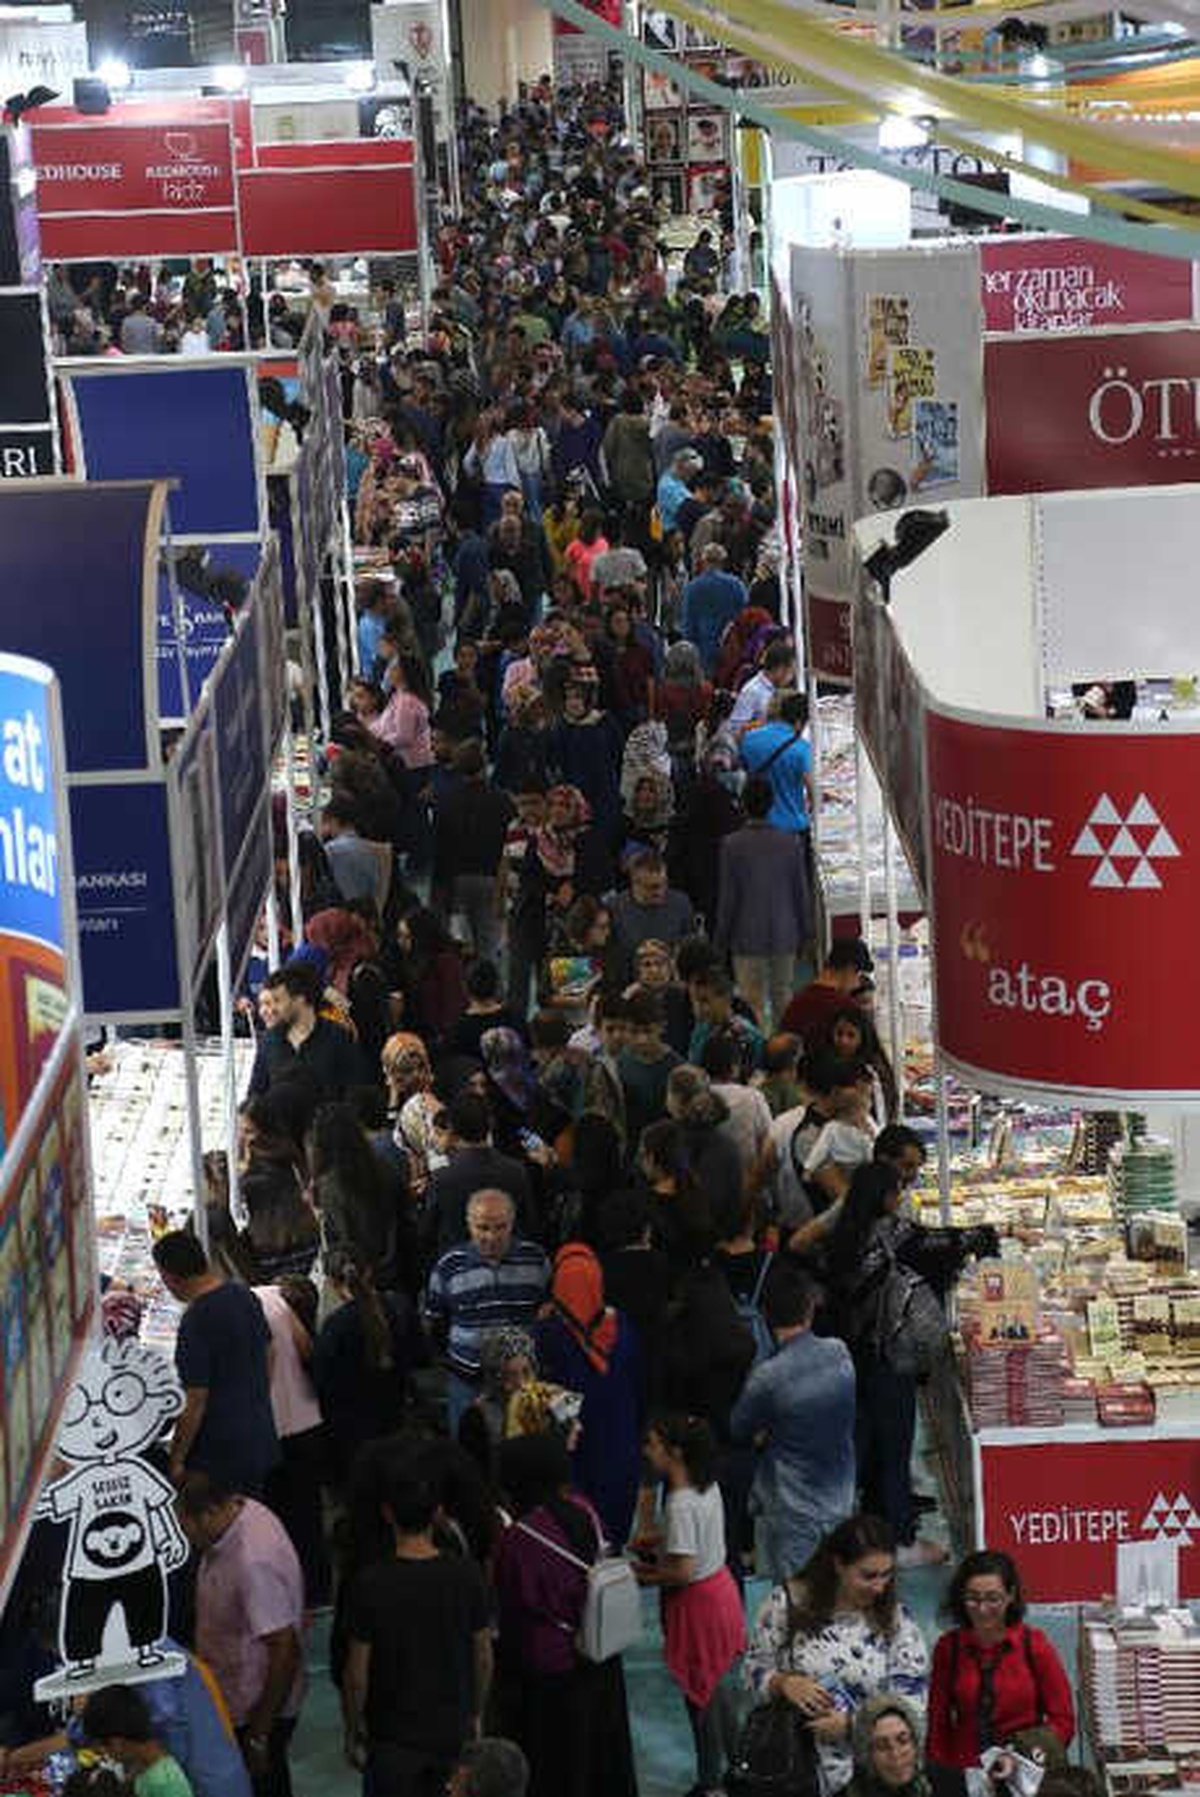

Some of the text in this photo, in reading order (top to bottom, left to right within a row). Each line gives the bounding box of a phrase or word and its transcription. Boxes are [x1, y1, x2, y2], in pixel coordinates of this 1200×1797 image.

[35, 164, 123, 181] EDHOUSE
[1013, 279, 1125, 313] okunacak
[1015, 265, 1095, 291] zaman
[1088, 366, 1200, 443] ÖT
[3, 447, 38, 477] RI
[3, 708, 45, 794] at
[933, 796, 1056, 871] YEDİTEPE
[987, 961, 1111, 1031] ataç
[1010, 1505, 1133, 1545] YEDİTEPE
